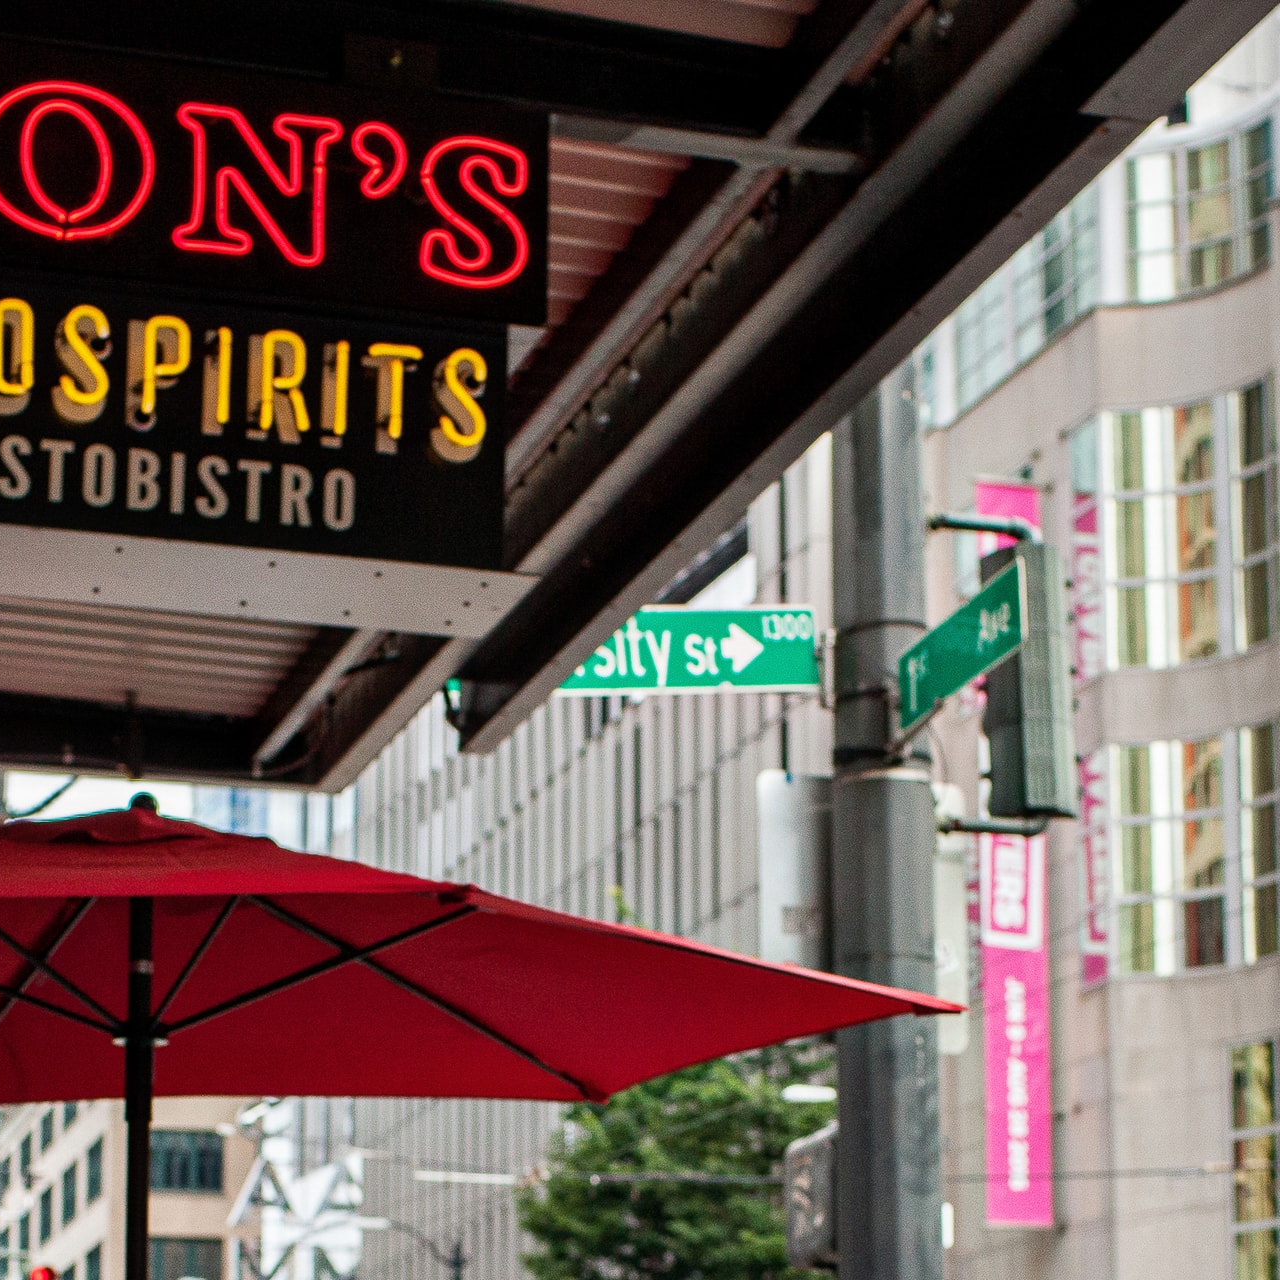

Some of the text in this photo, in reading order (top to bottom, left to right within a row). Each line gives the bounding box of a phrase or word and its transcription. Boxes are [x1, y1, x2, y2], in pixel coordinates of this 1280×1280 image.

[574, 615, 671, 687] sity
[761, 613, 813, 640] 1300
[977, 602, 1012, 652] Ave
